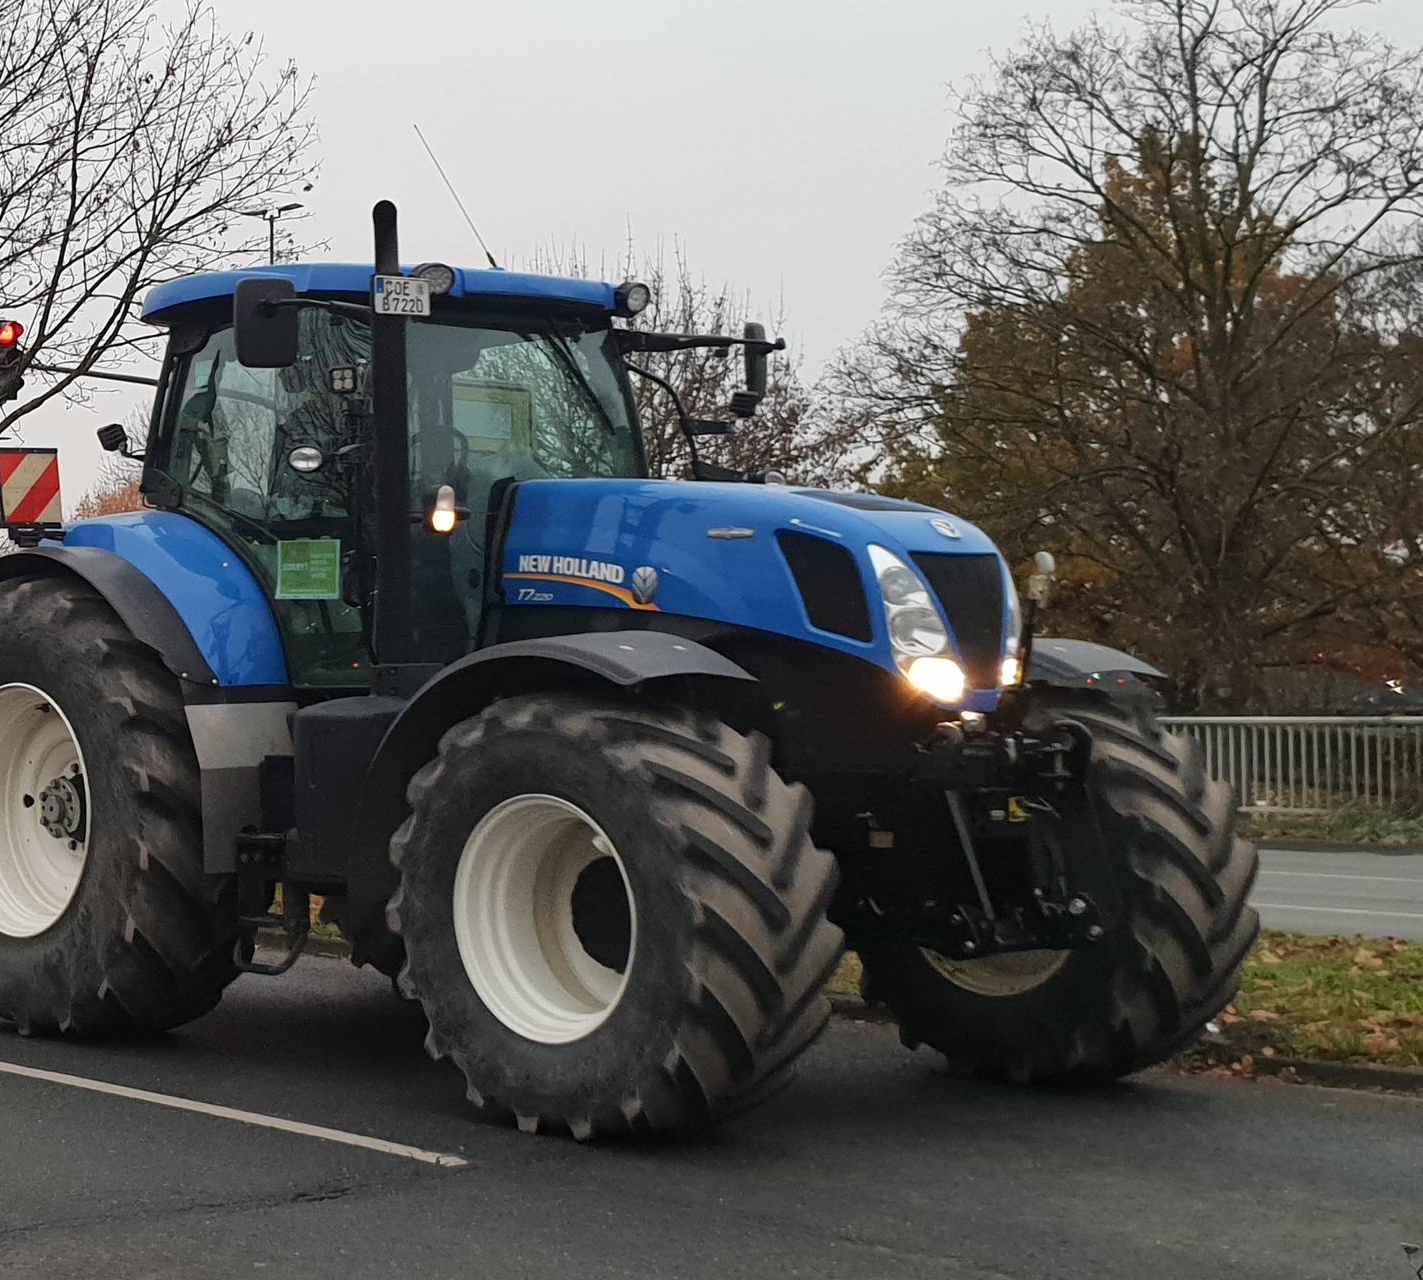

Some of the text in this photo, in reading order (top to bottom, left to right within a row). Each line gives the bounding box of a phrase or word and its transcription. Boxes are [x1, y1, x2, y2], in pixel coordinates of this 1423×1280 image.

[385, 280, 410, 296] COE
[519, 555, 624, 583] NEW HOLLAND
